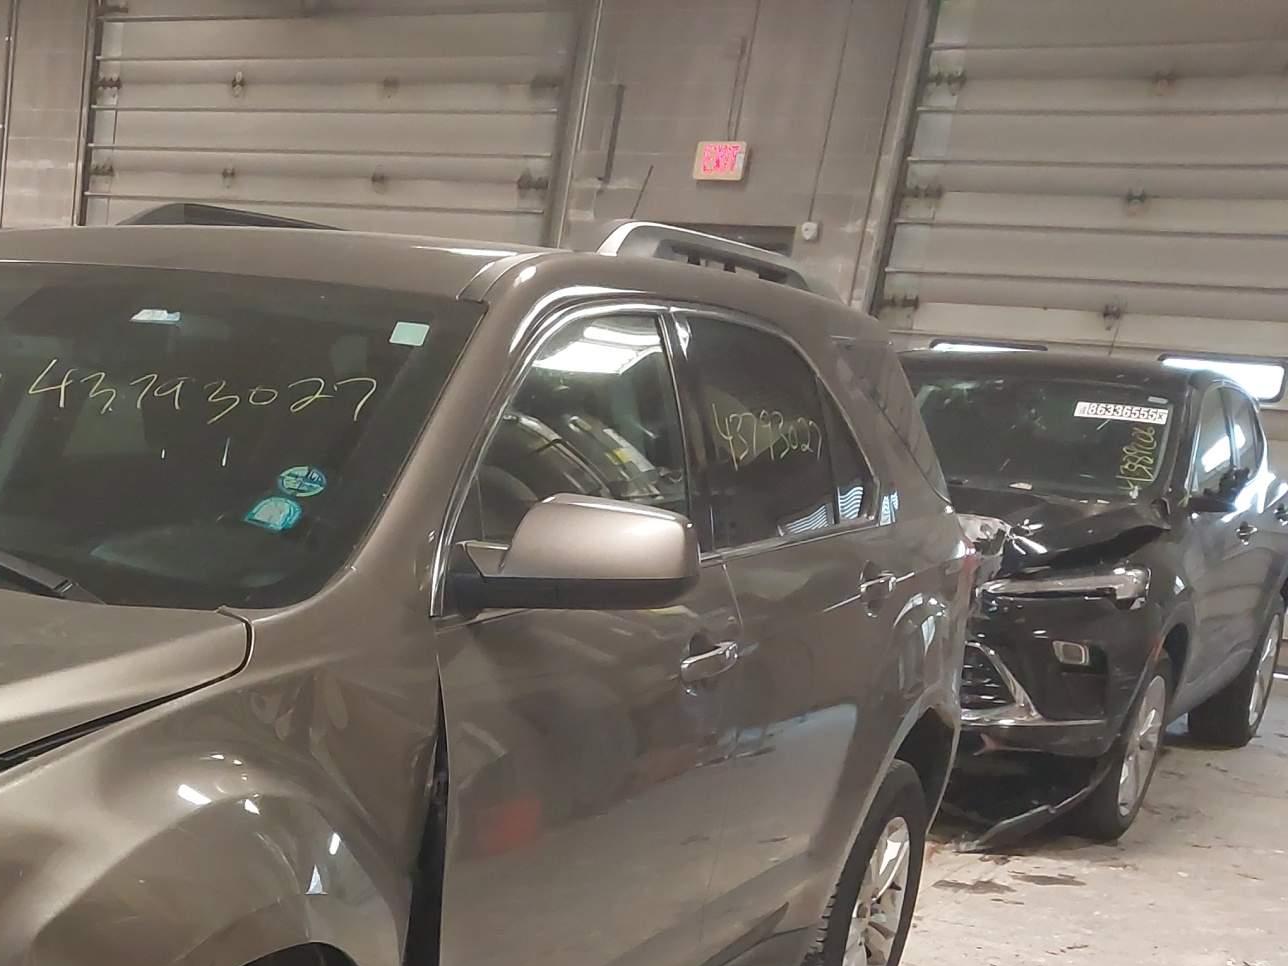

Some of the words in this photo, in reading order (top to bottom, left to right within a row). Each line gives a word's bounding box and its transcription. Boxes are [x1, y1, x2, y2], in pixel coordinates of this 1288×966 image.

[702, 143, 739, 174] EXIT
[28, 359, 377, 424] 43793027
[712, 403, 823, 471] 43793027
